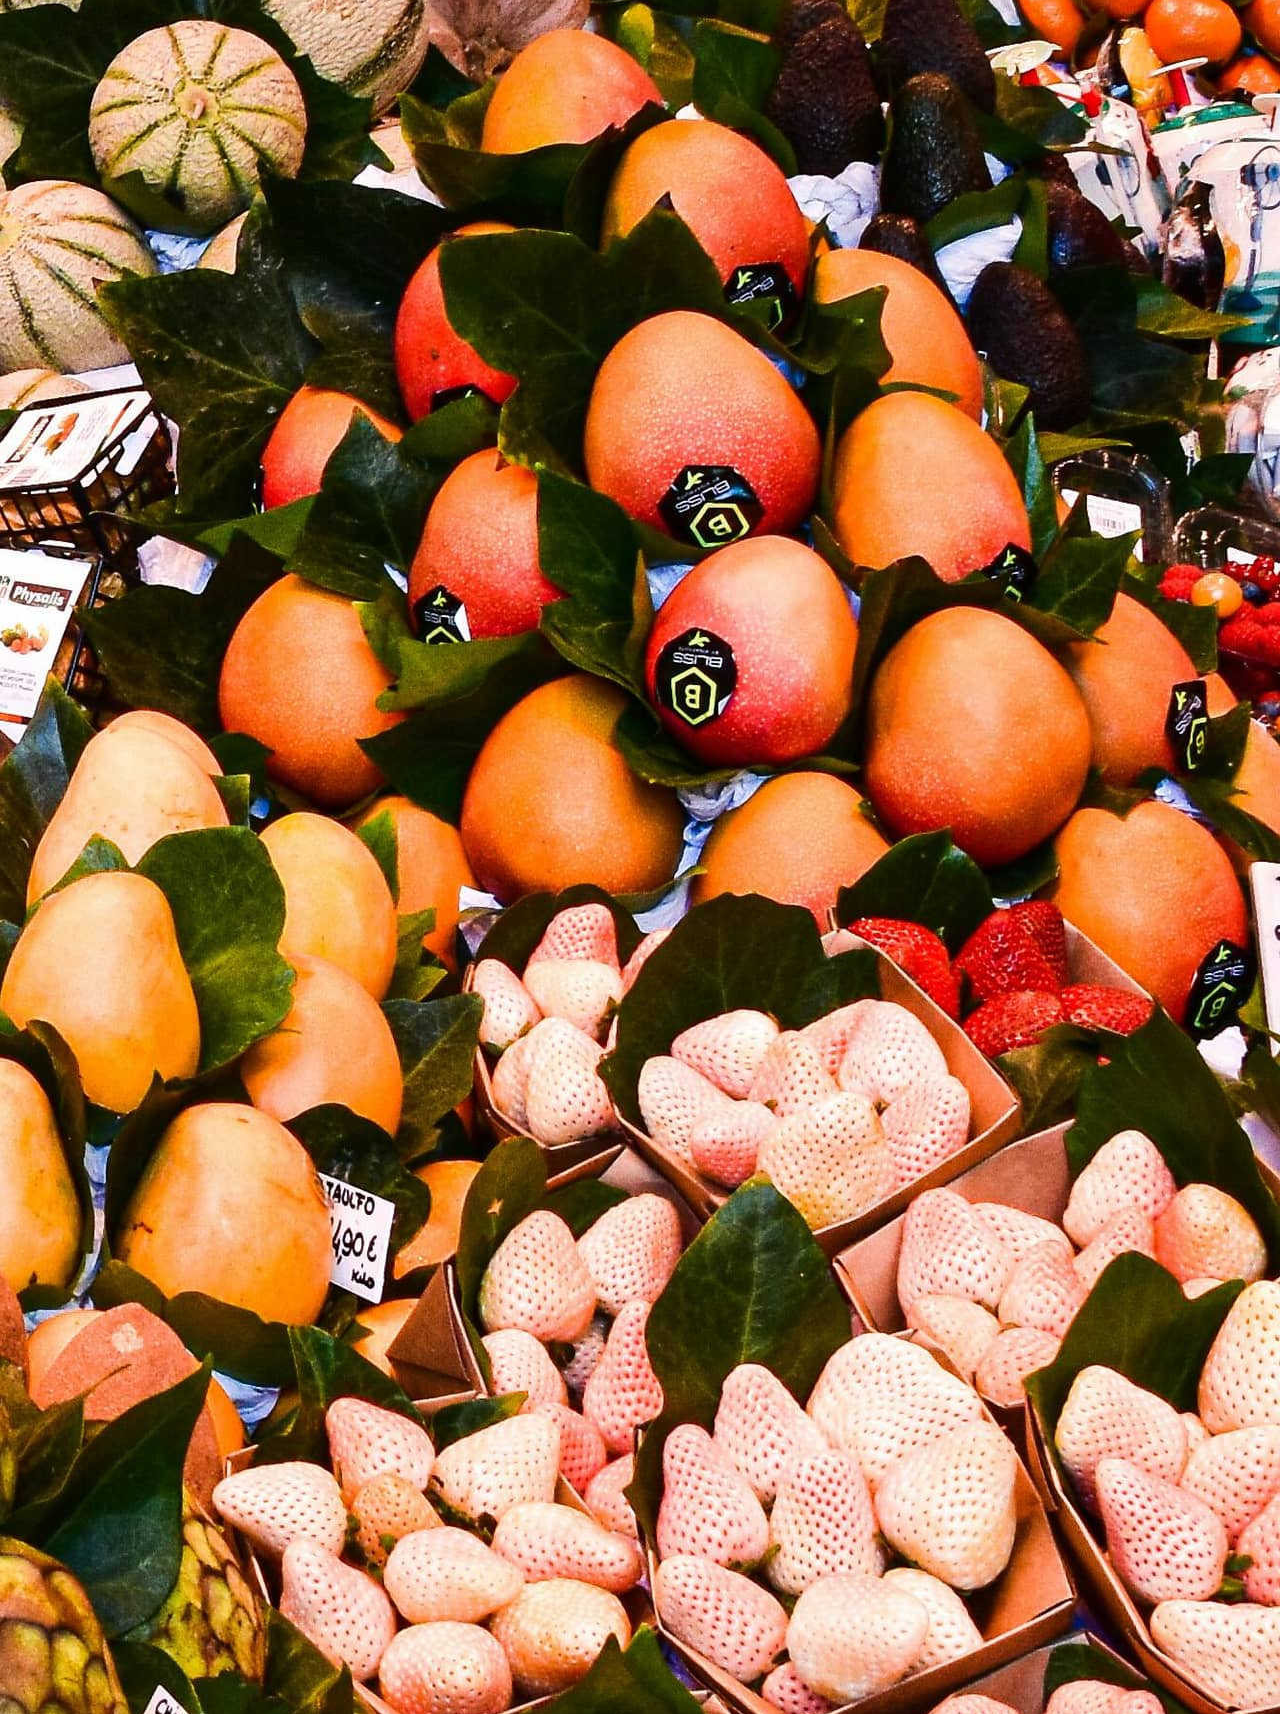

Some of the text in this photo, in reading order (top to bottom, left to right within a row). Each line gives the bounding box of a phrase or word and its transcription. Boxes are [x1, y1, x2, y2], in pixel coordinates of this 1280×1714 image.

[675, 480, 731, 514] BLISS
[708, 513, 732, 536] B
[12, 585, 66, 608] Physalis
[672, 650, 724, 669] BLISS
[684, 684, 701, 709] B
[325, 1180, 376, 1216] TAULFO
